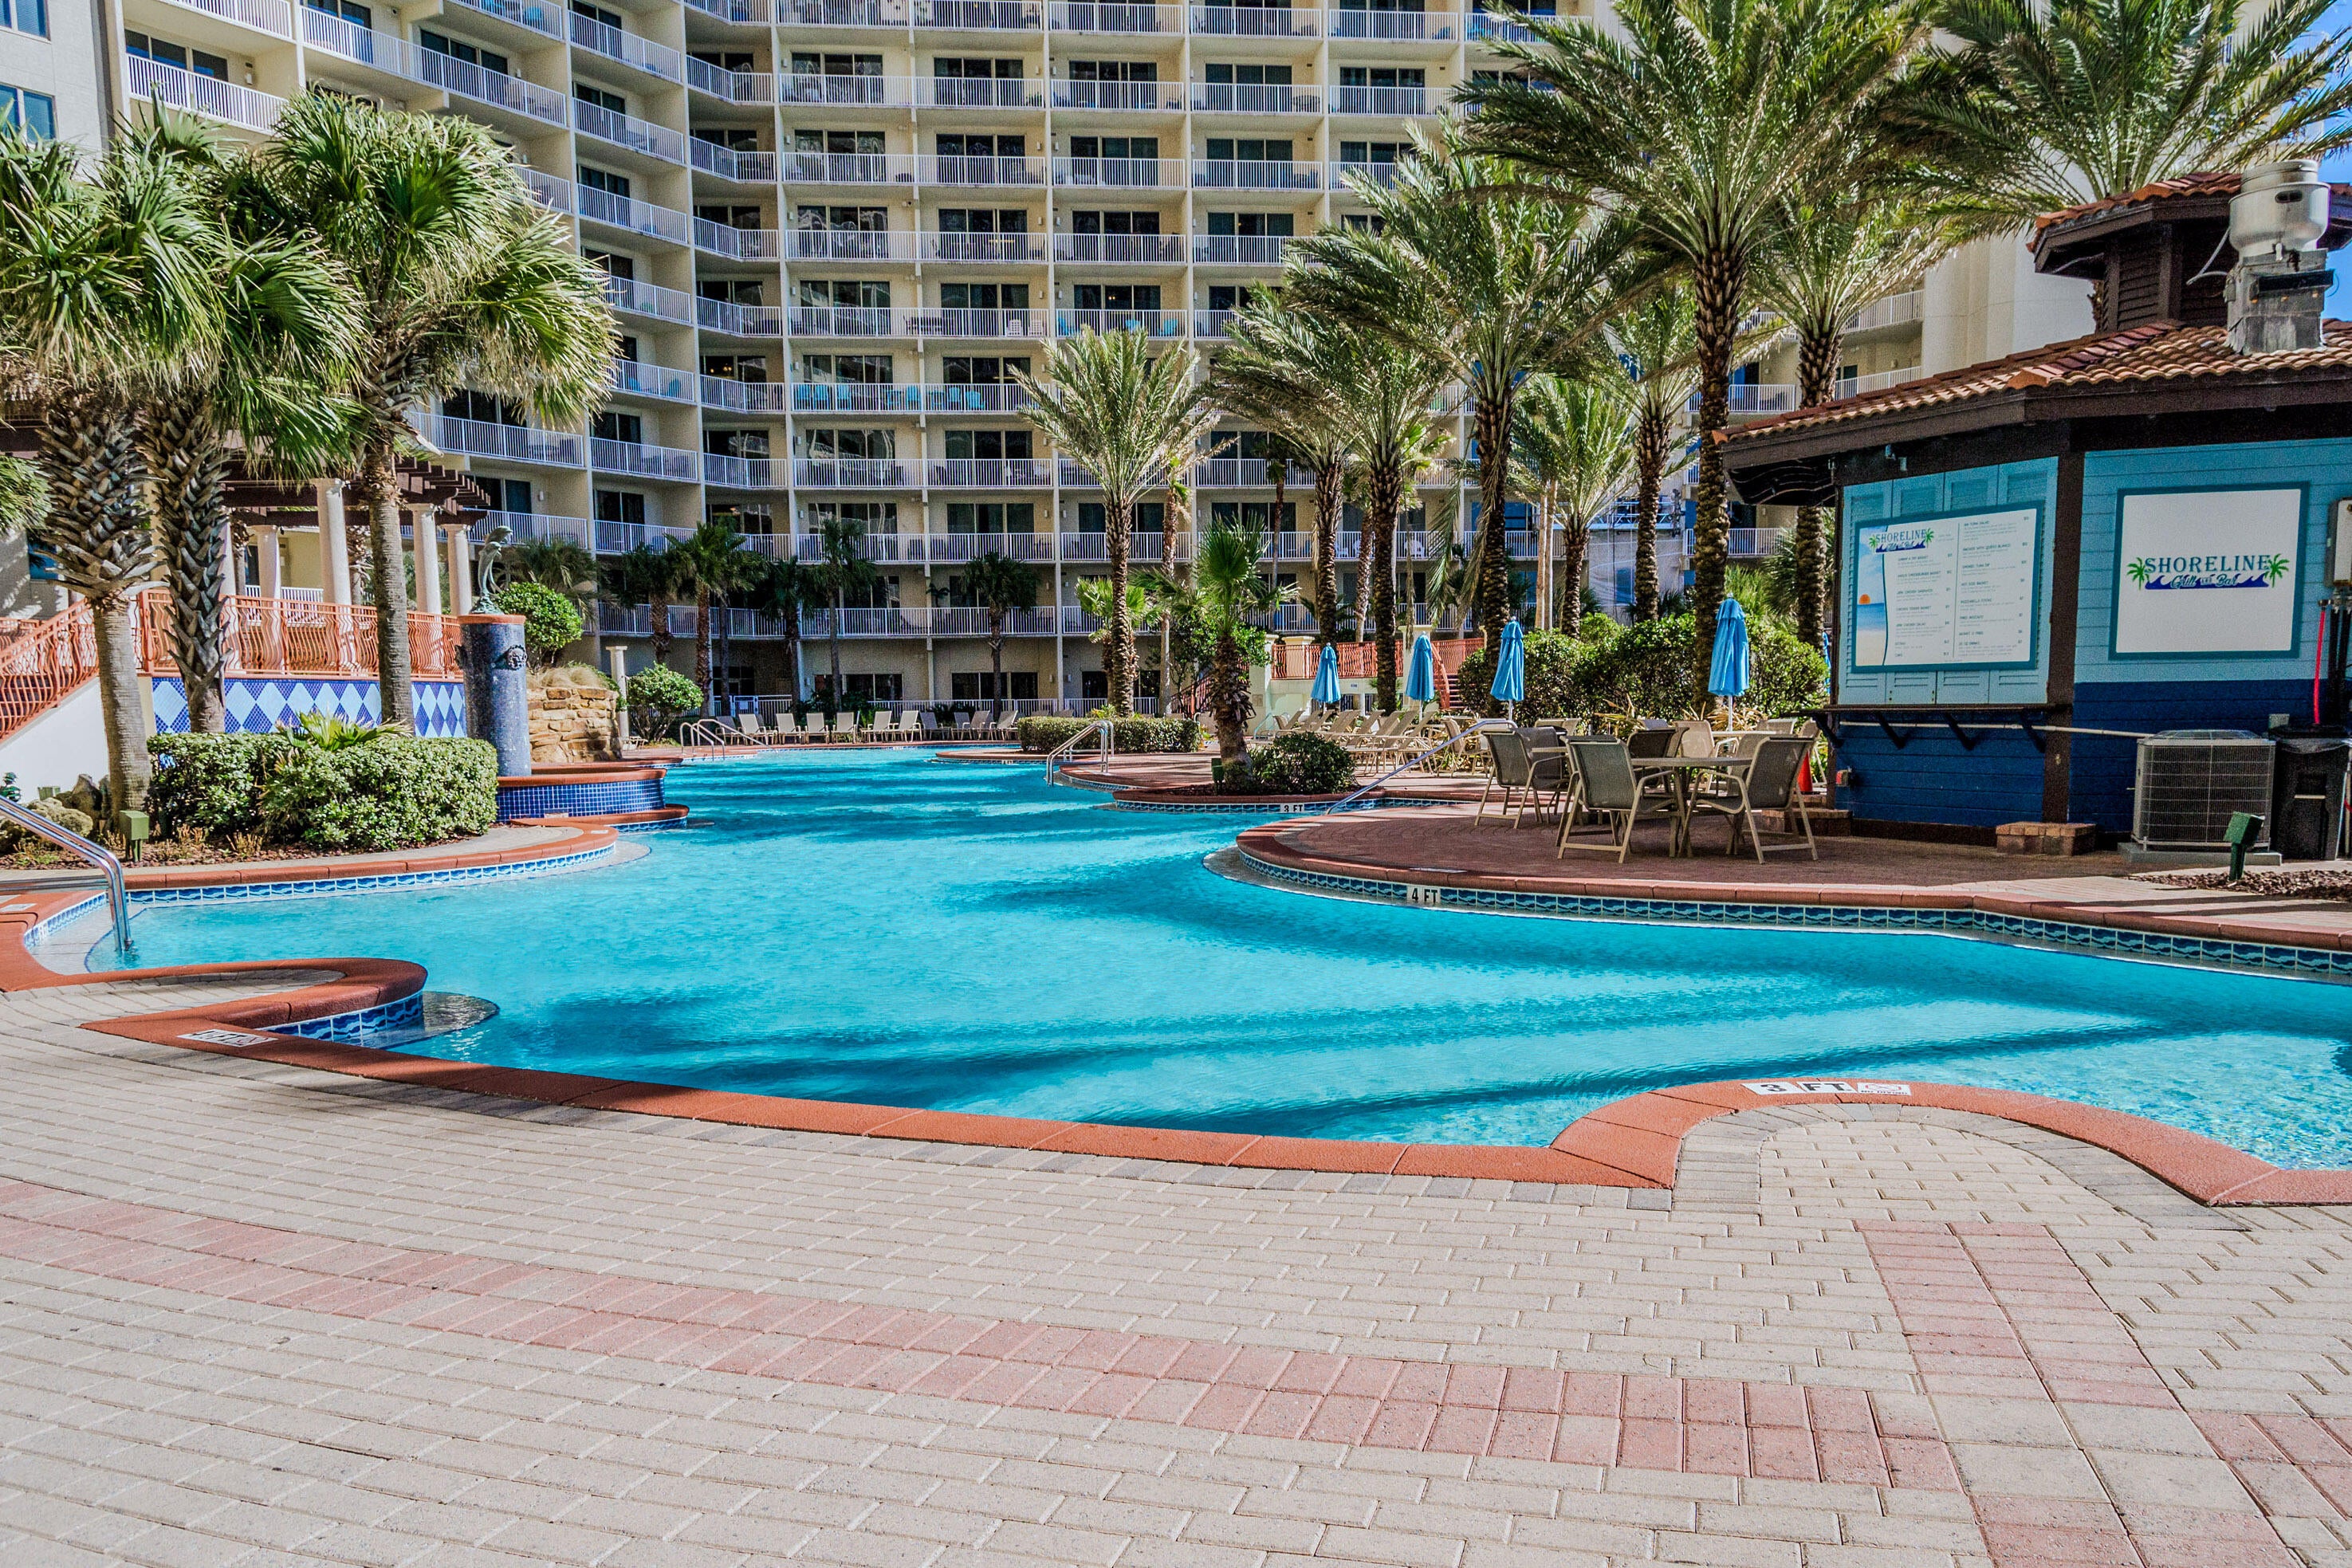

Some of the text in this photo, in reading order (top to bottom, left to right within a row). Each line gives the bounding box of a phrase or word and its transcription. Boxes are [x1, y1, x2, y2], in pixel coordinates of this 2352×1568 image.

[1875, 529, 1926, 543] SHORELINE
[2144, 555, 2271, 573] SHORELINE
[2216, 573, 2237, 586] Bar
[1412, 887, 1438, 902] 4 FT
[1760, 1083, 1788, 1092] 3
